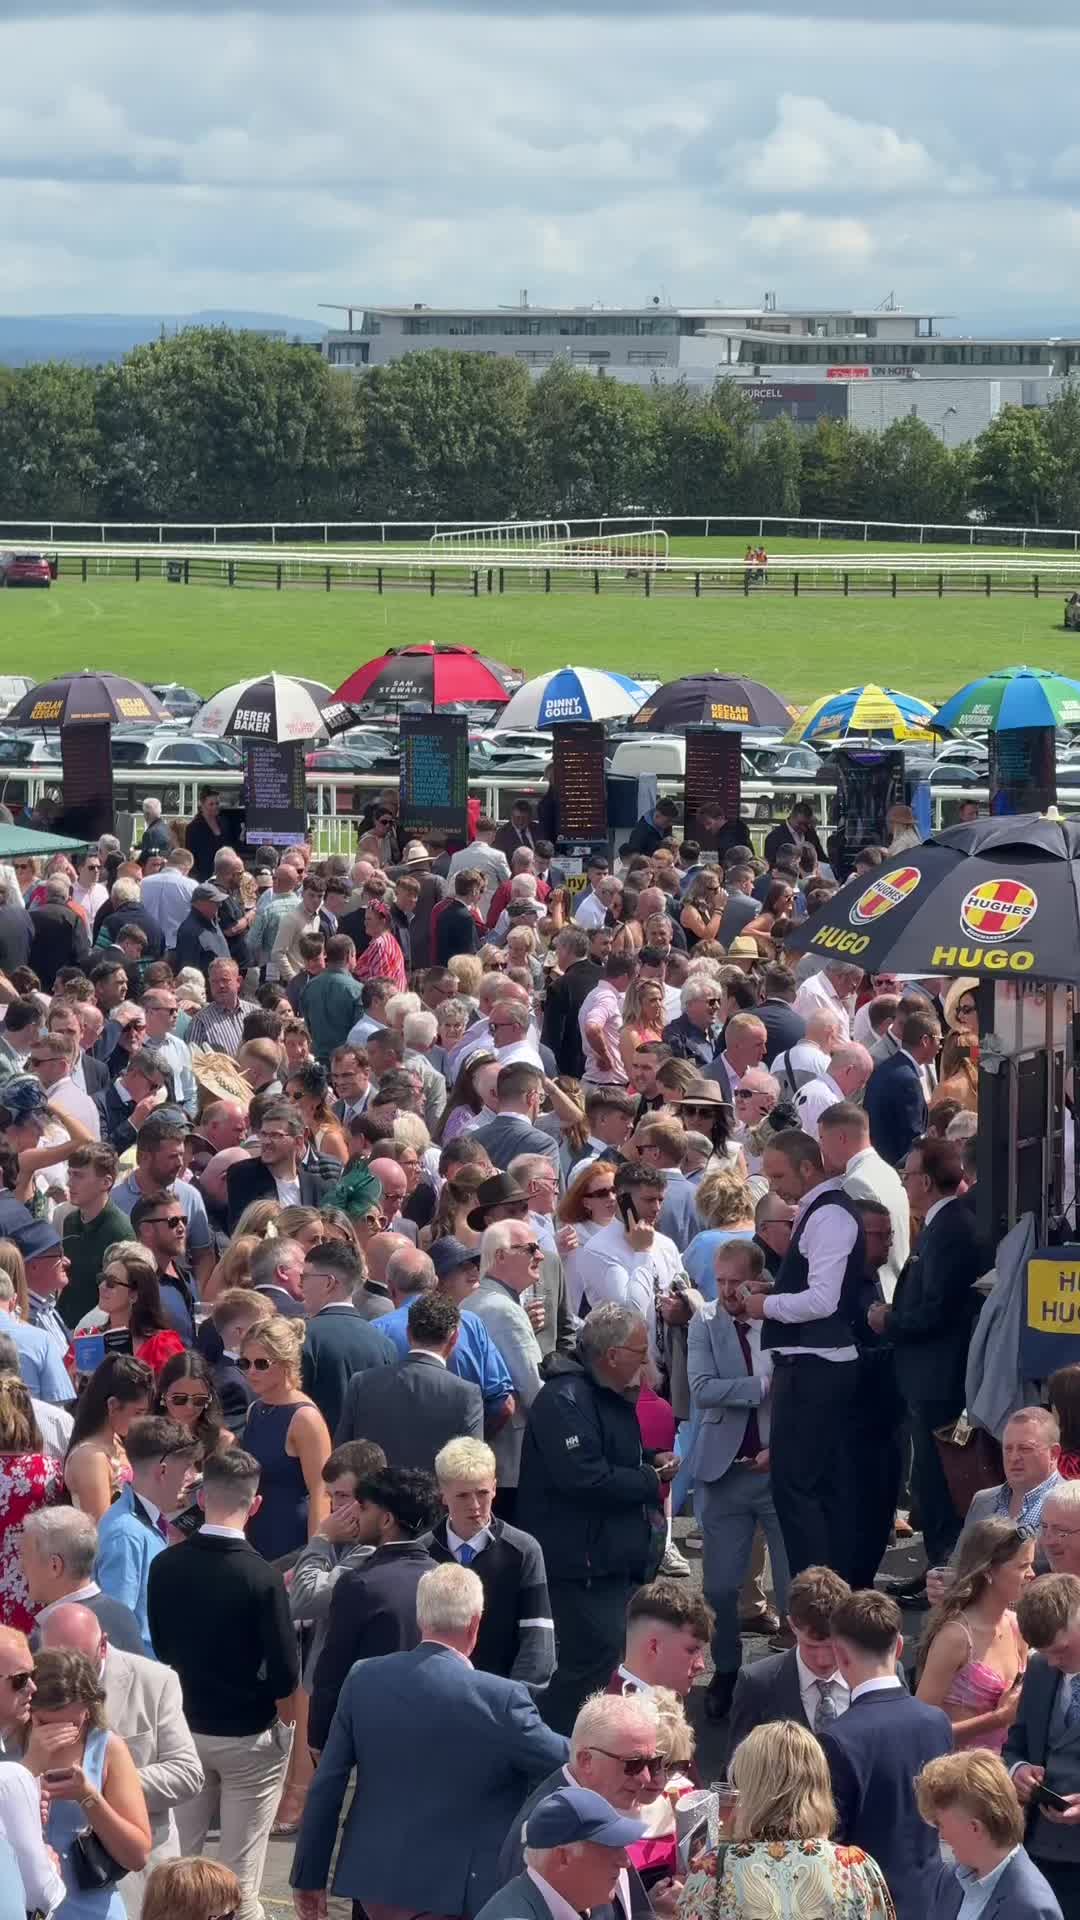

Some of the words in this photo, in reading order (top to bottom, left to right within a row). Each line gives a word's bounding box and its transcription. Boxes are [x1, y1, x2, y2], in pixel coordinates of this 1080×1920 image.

[888, 367, 913, 376] HOTE
[741, 389, 783, 398] PURCELL
[546, 697, 580, 708] DINNY
[711, 703, 749, 713] DECLAN
[30, 709, 60, 720] KEEGAN
[236, 709, 272, 723] DEREK
[545, 705, 582, 718] GOULD
[711, 711, 749, 722] KEEGAN
[233, 720, 270, 733] BAKER
[872, 879, 904, 902] HUGHES
[967, 897, 1032, 917] HUGHES
[810, 925, 871, 954] HUGO
[931, 946, 1035, 970] HUGO
[1059, 1271, 1080, 1292] H
[1042, 1301, 1080, 1323] HU
